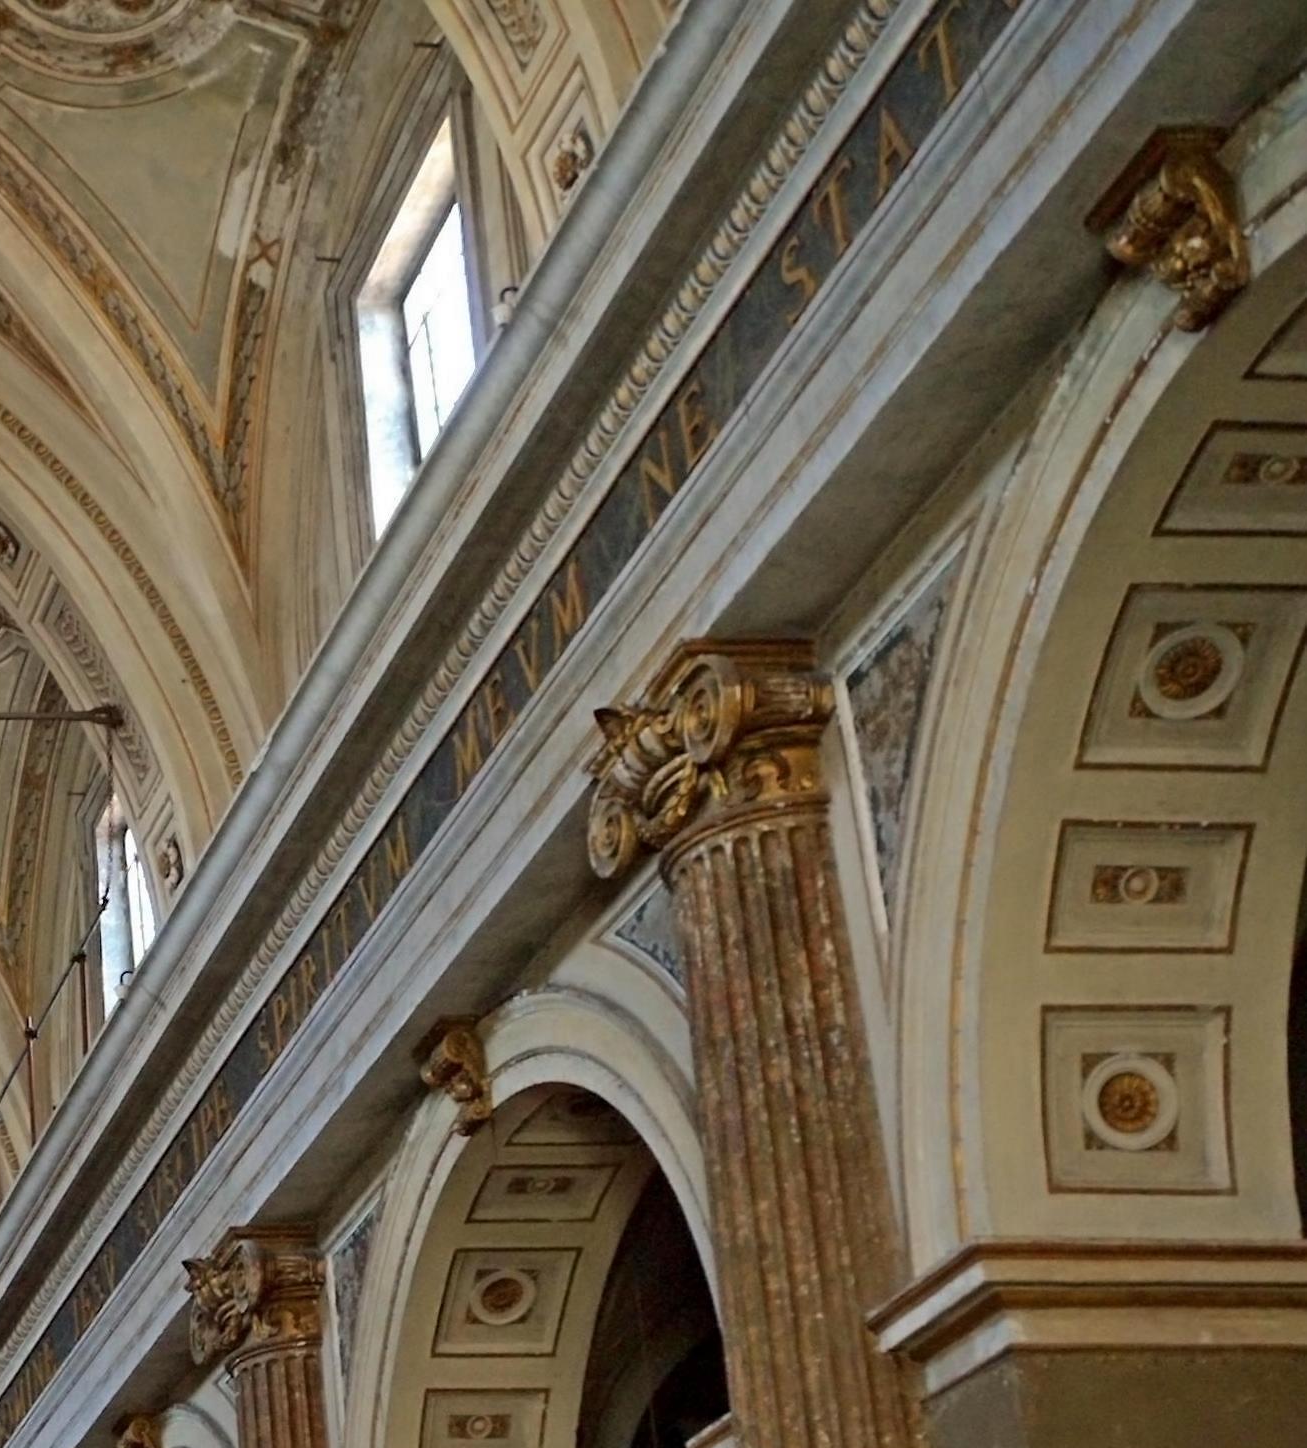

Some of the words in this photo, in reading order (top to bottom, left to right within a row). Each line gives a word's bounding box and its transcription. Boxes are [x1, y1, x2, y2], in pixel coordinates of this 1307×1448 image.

[257, 814, 411, 1077] SPIRITVM
[451, 559, 585, 803] MEVM
[640, 380, 719, 531] NE
